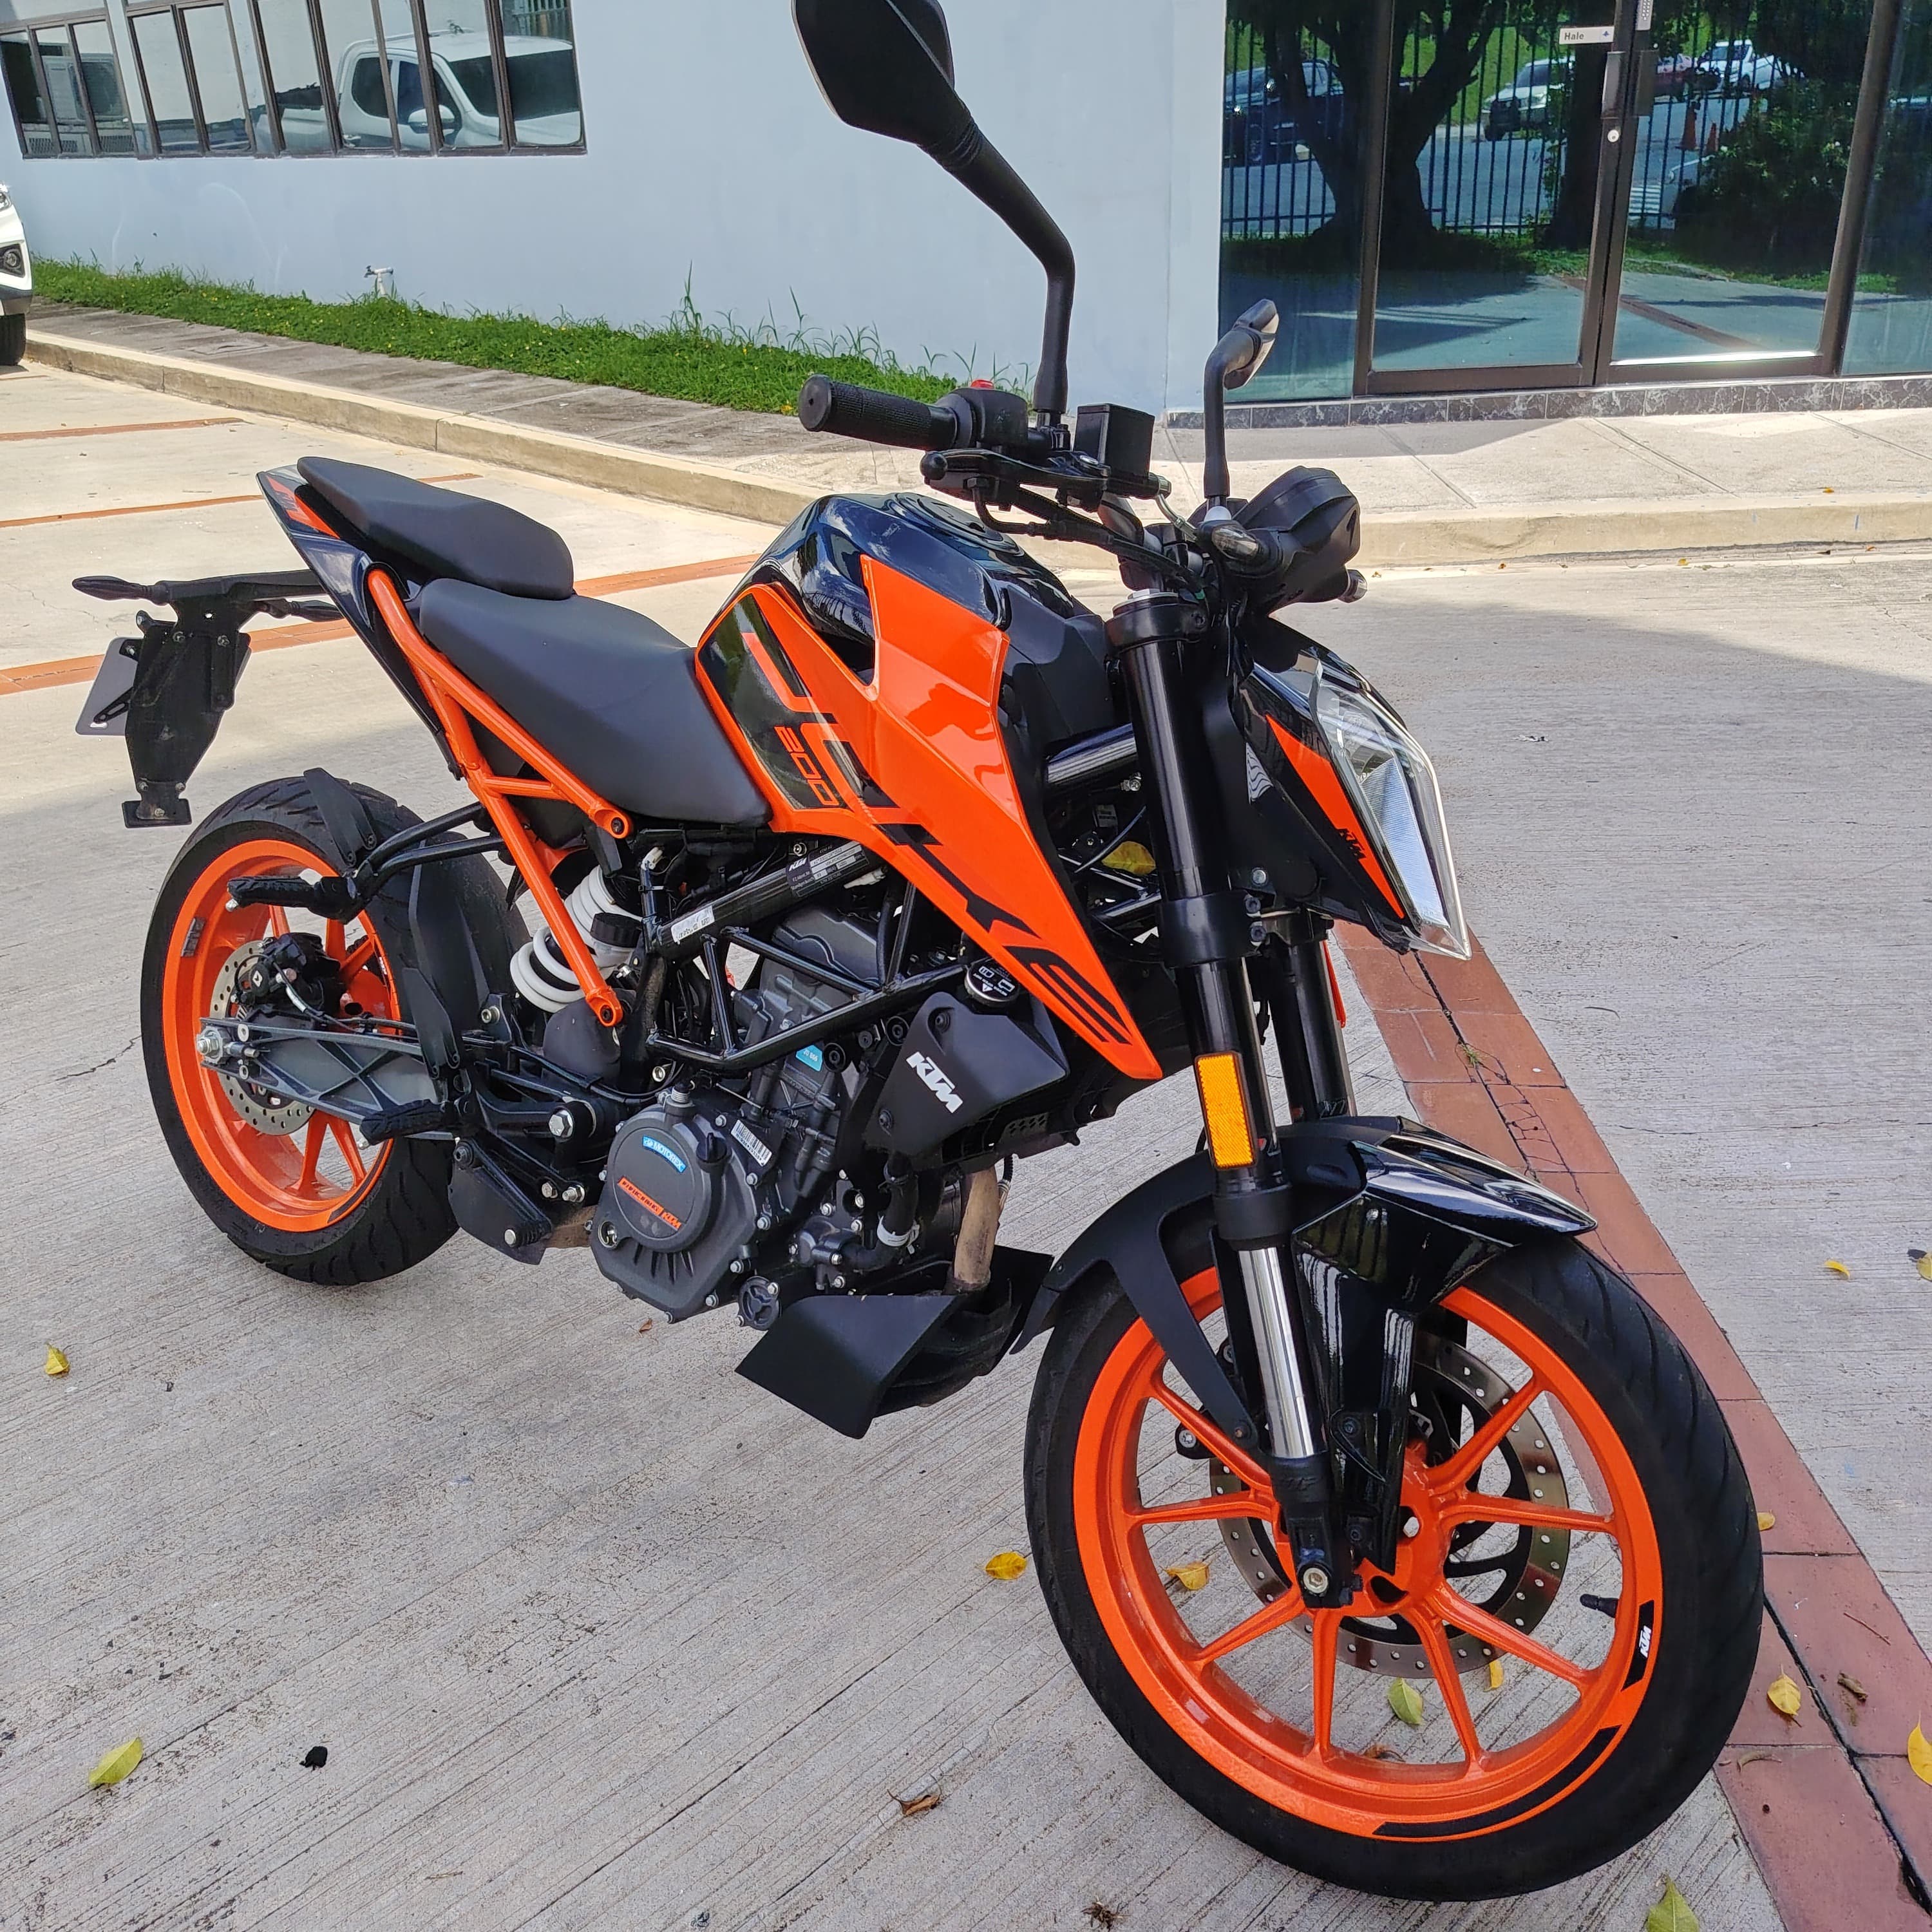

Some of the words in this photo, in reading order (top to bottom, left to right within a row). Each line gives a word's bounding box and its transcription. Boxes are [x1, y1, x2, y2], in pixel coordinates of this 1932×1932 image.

[1564, 31, 1584, 40] Hale
[774, 726, 840, 806] 200
[1336, 828, 1366, 860] KTM
[789, 857, 807, 871] KTM
[906, 1051, 963, 1113] KTM
[653, 1141, 683, 1168] MOTOREX
[1638, 1625, 1651, 1658] KTM
